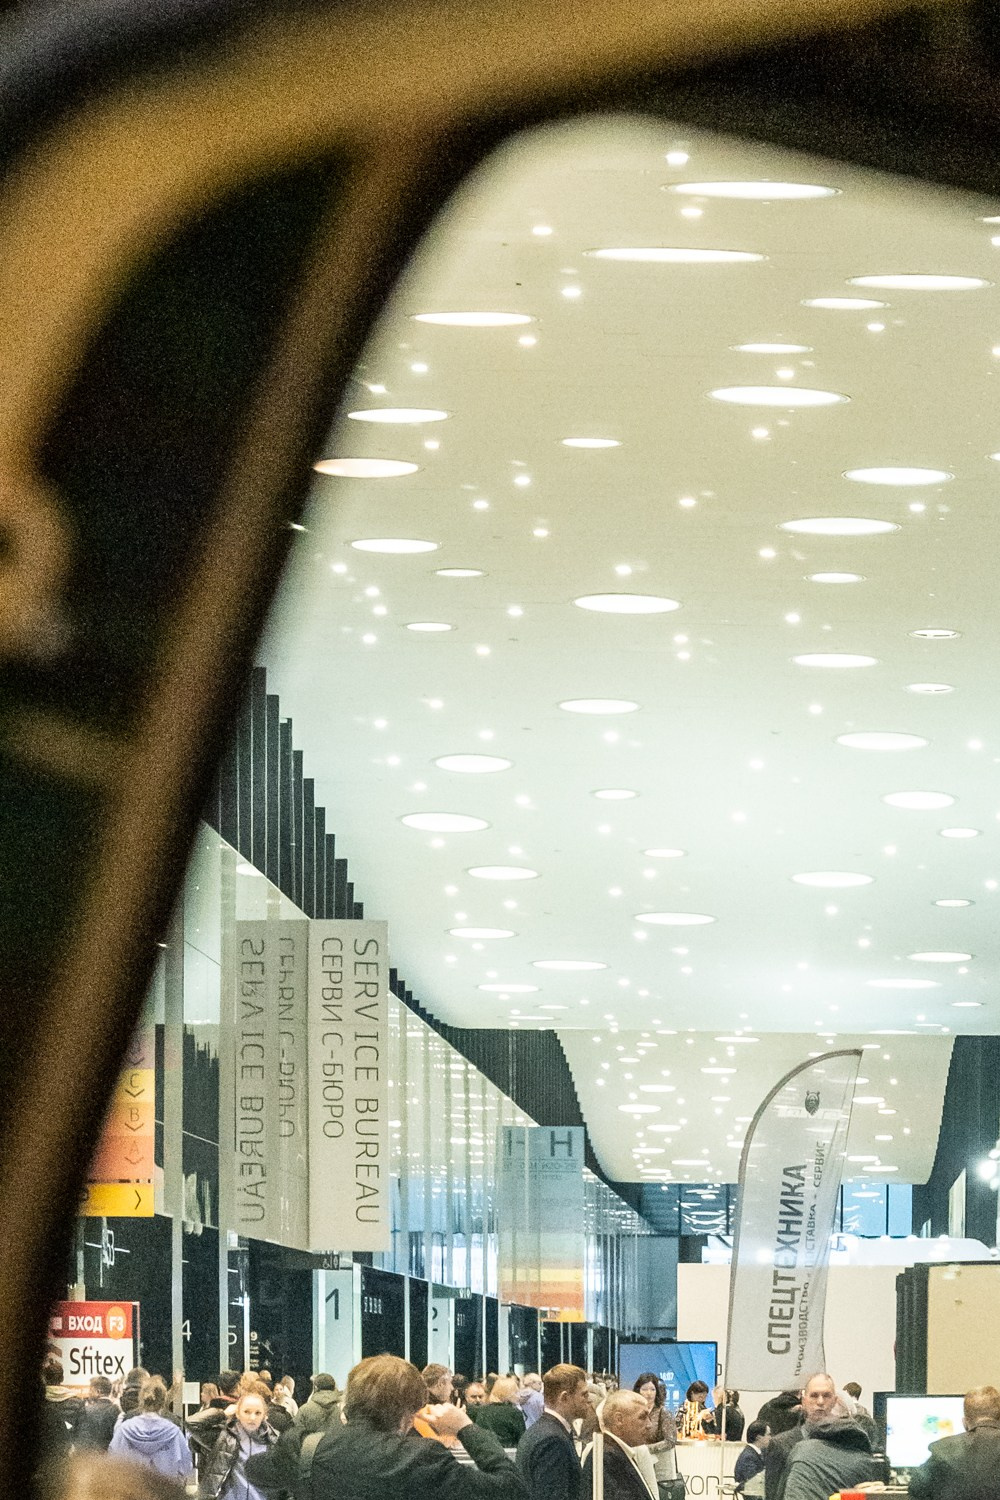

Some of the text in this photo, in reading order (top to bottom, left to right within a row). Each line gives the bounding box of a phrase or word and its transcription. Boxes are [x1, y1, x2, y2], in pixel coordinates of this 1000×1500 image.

[321, 937, 345, 1139] СЕРВИС-БЮРО
[130, 1073, 140, 1089] C
[354, 938, 380, 1223] SERVICE BUREAU
[130, 1108, 140, 1122] B
[550, 1130, 573, 1157] H
[812, 1140, 827, 1188] СЕРВИС
[767, 1164, 807, 1356] СПЕЦТЕХНИКА
[325, 1288, 339, 1320] 1
[68, 1315, 124, 1333] ВХОД F3
[181, 1319, 192, 1342] 4
[250, 1331, 258, 1341] 9
[69, 1346, 125, 1375] Sfitex
